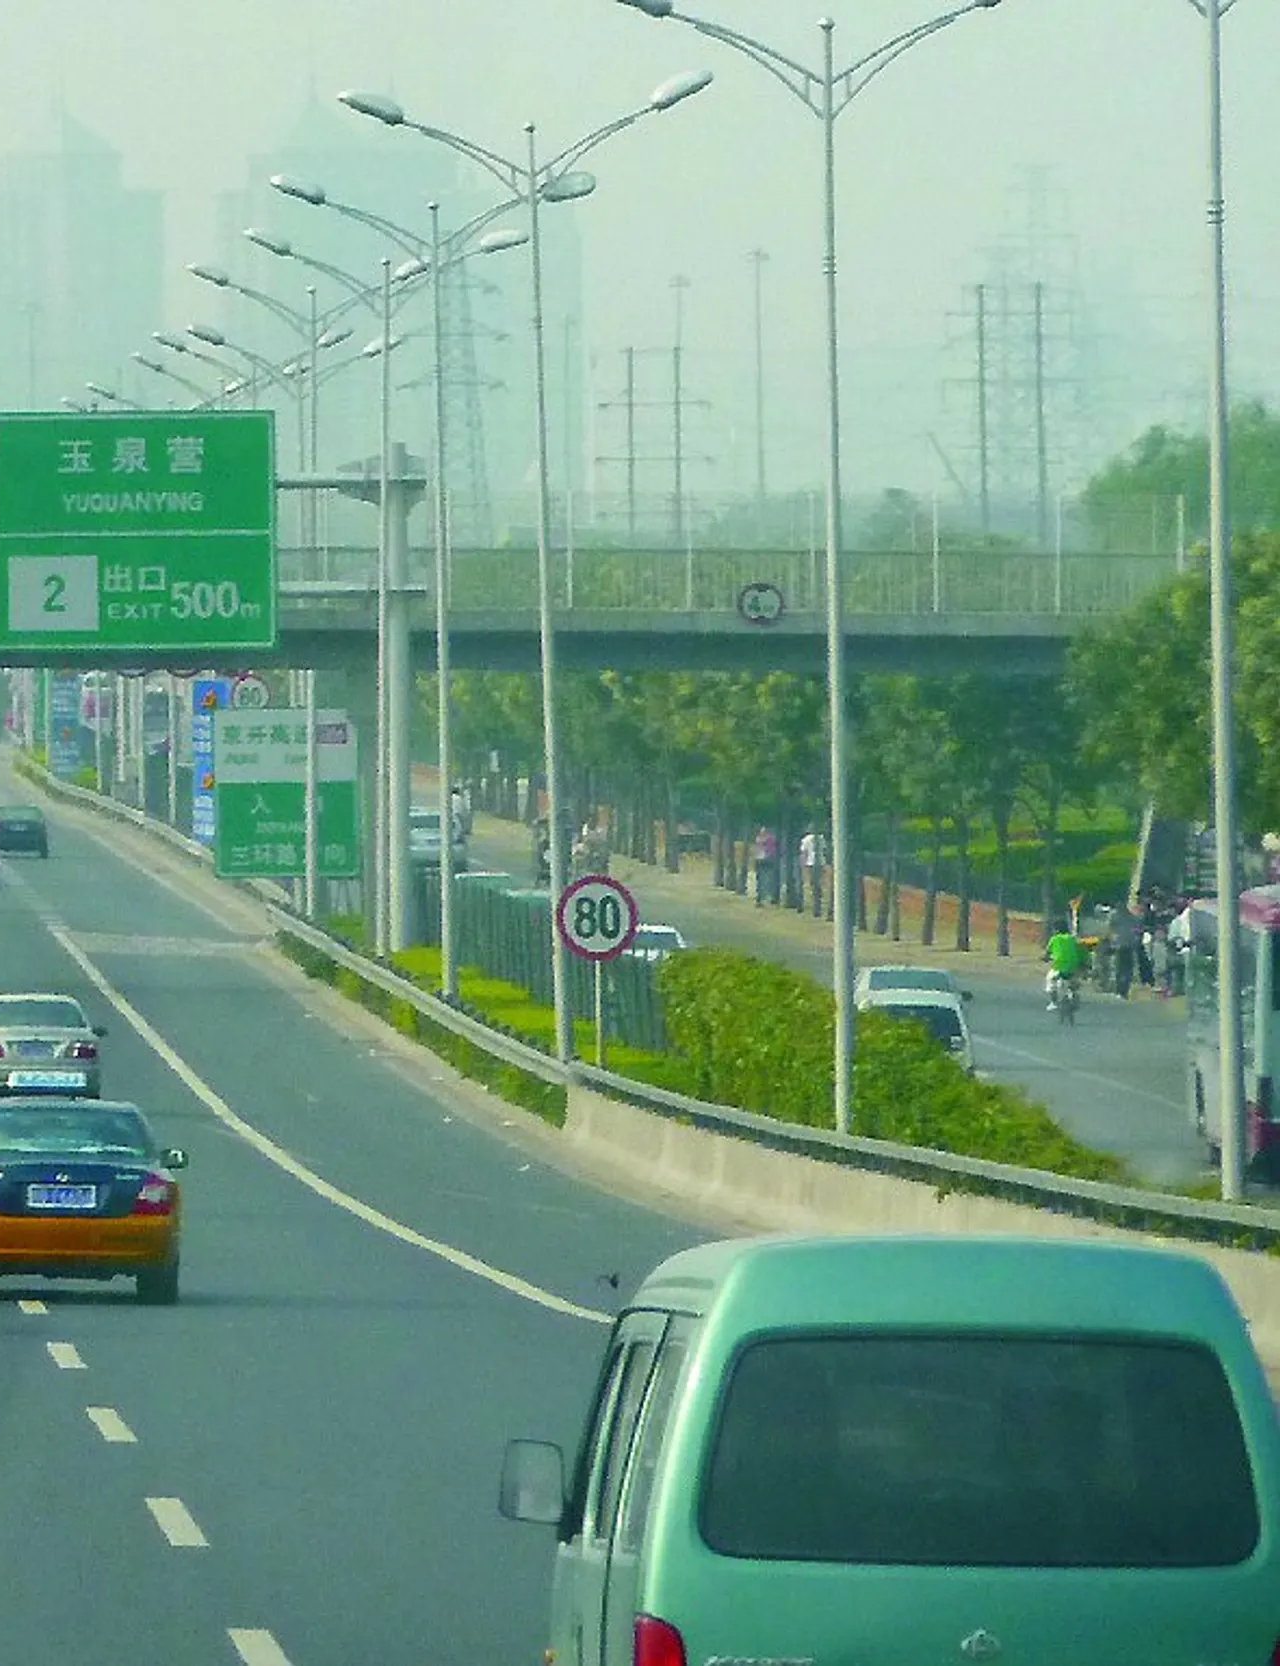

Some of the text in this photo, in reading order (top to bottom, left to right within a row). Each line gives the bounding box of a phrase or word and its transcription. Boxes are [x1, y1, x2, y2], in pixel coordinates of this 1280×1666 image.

[58, 436, 205, 474] 玉泉营
[62, 491, 204, 513] YUQUANYING
[43, 573, 66, 613] 2
[103, 565, 167, 593] 出口
[108, 603, 165, 620] EXIT
[574, 895, 620, 939] 80
